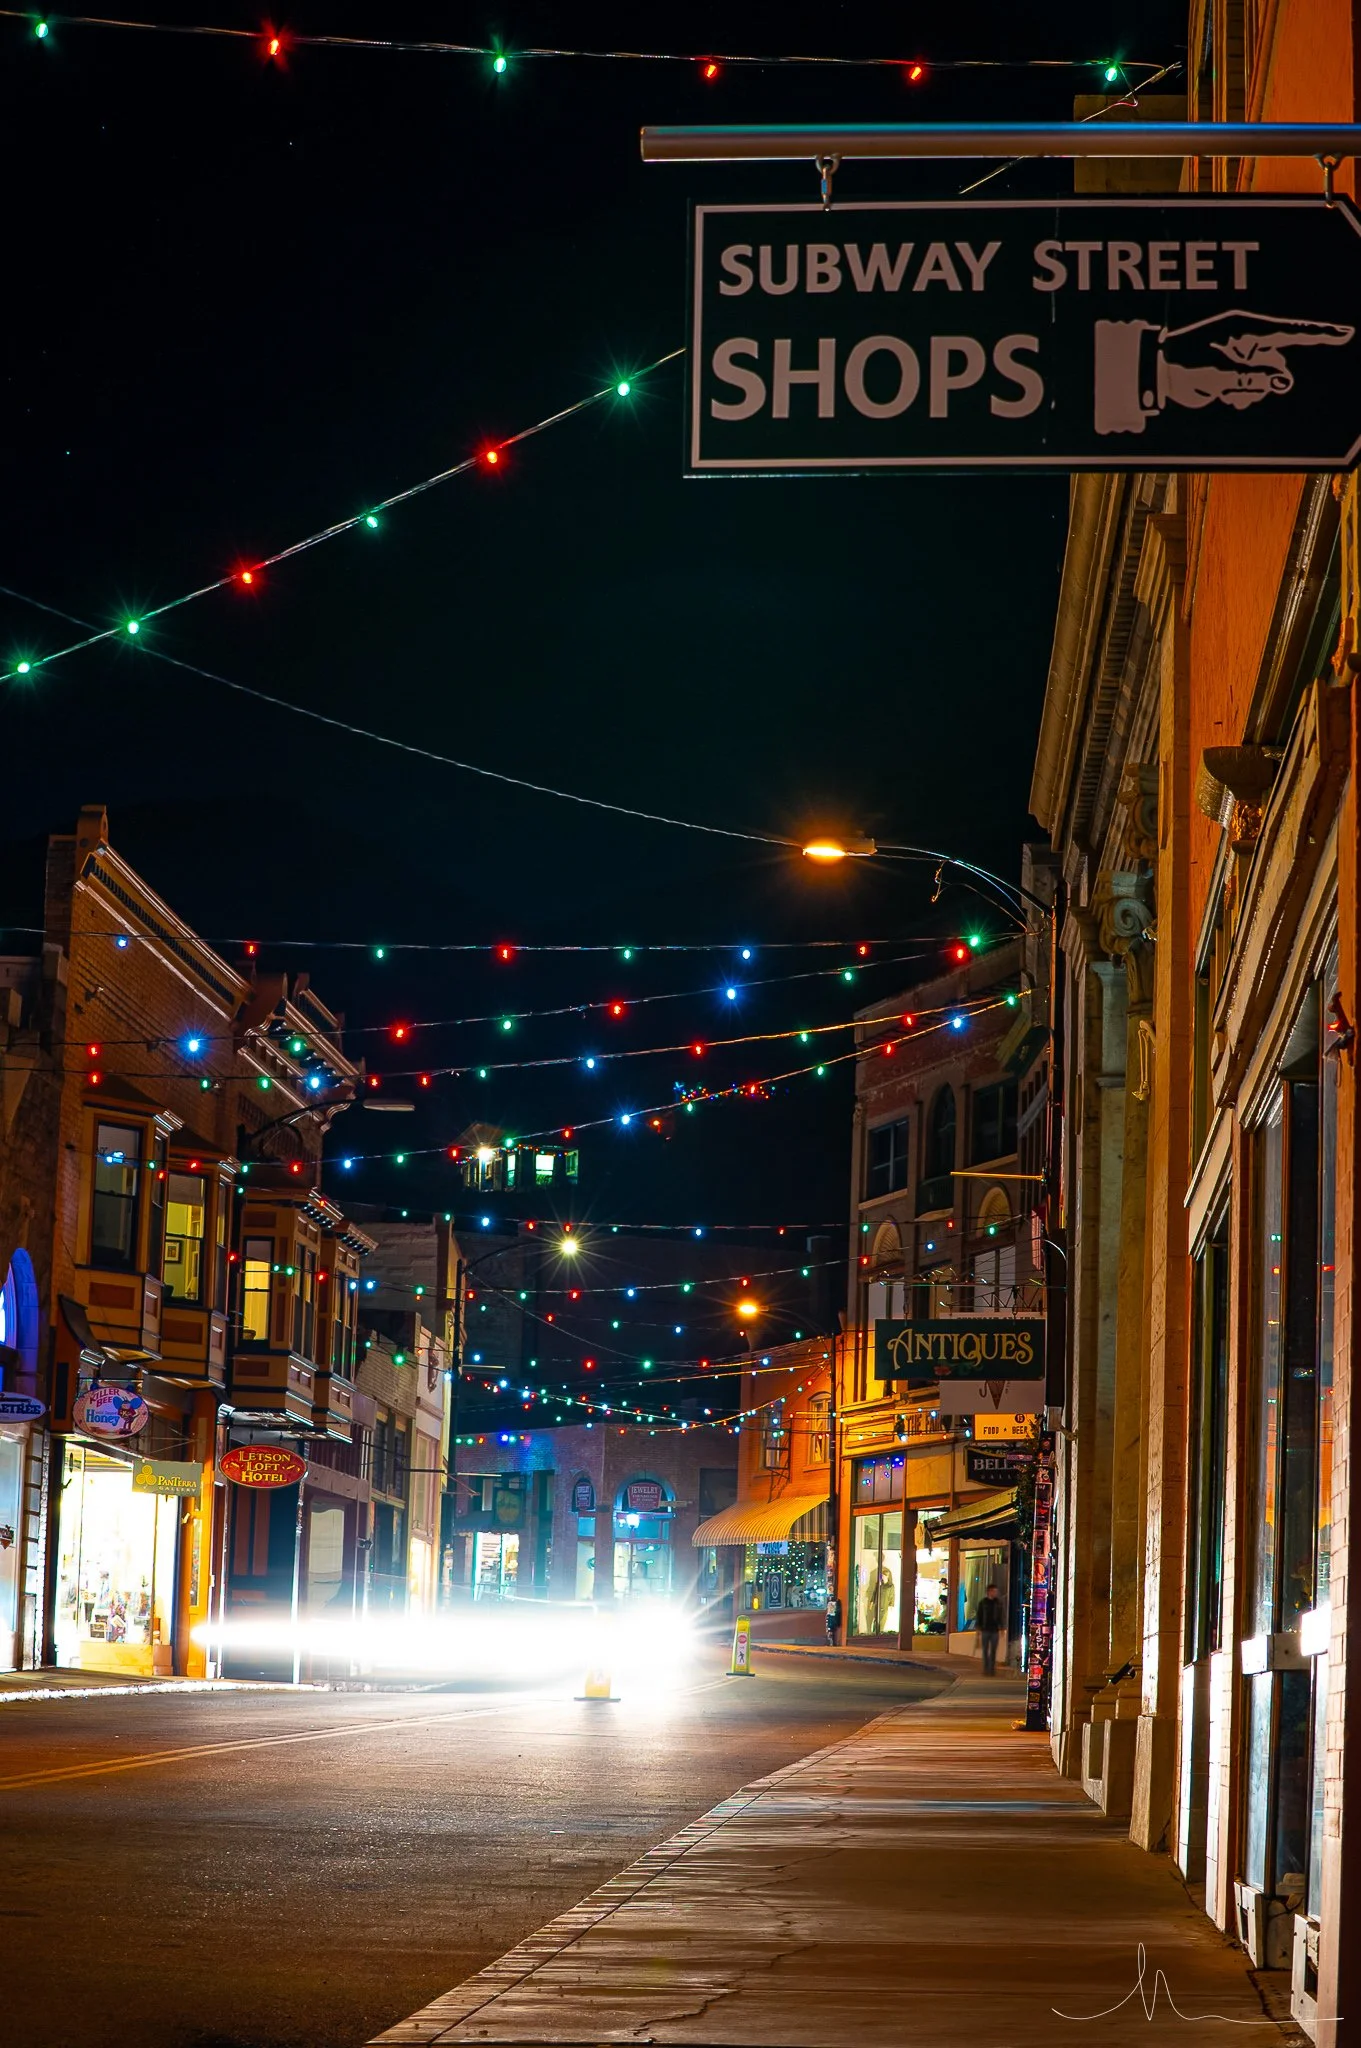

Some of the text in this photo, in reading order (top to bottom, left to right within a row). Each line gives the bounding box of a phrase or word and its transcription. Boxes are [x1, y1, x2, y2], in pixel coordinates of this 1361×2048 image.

[718, 239, 1260, 297] SUBWAY STREET
[711, 333, 1044, 422] SHOPS
[887, 1328, 1034, 1371] ANTIQUES
[90, 1388, 120, 1405] KILLER
[96, 1396, 113, 1407] BEE
[86, 1409, 120, 1426] Honey
[983, 1426, 1028, 1434] FOOD BEER
[238, 1450, 291, 1462] LETSON
[246, 1461, 280, 1472] LOFT
[241, 1471, 287, 1482] HOTEL
[631, 1486, 658, 1494] JEWELRY
